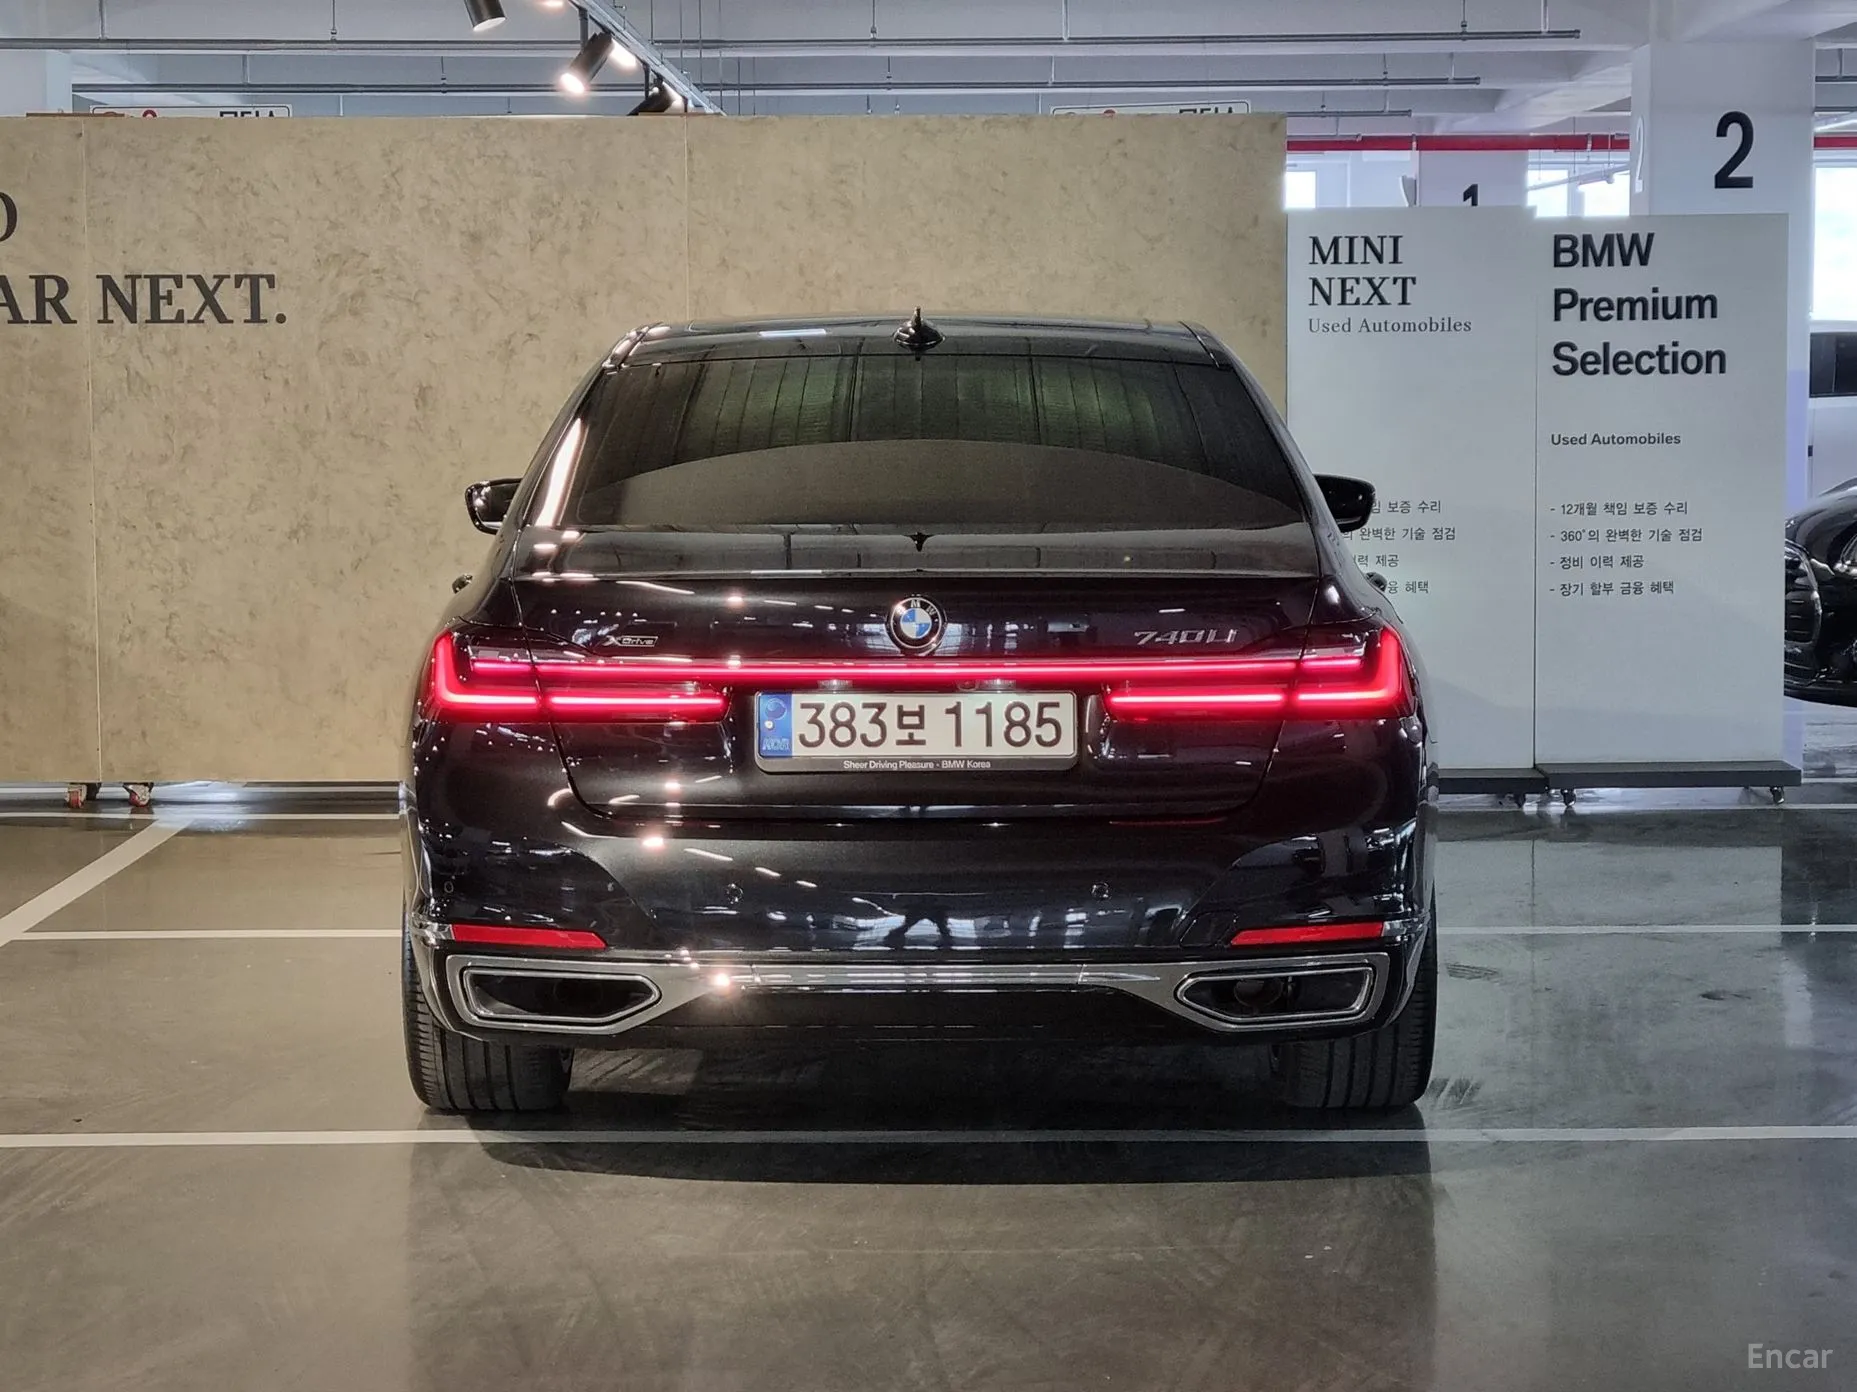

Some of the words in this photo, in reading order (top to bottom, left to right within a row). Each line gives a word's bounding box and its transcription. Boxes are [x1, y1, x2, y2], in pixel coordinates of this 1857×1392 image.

[1714, 111, 1754, 189] 2
[1308, 235, 1403, 264] MINI
[1553, 232, 1655, 267] BMW
[1308, 276, 1417, 306] NEXT
[96, 274, 286, 324] NEXT.
[1553, 287, 1718, 322] Premium
[1308, 317, 1351, 333] Used
[1358, 316, 1472, 332] Automobiles
[1552, 341, 1726, 376] Selection
[1551, 433, 1587, 445] Used
[1591, 432, 1681, 445] Automobiles
[1387, 500, 1411, 513] 보증
[1418, 500, 1441, 513] 수리
[1560, 502, 1597, 516] 12개월
[1603, 501, 1627, 515] 책임
[1633, 501, 1658, 515] 보증
[1664, 501, 1688, 515] 수리
[1360, 527, 1396, 540] 완벽한
[1402, 527, 1425, 540] 기술
[1432, 527, 1456, 540] 점검
[1605, 528, 1642, 542] 완벽한
[1649, 528, 1672, 542] 기술
[1678, 528, 1703, 541] 점검
[1354, 554, 1368, 567] 력
[1375, 554, 1399, 567] 제공
[1560, 556, 1583, 569] 정비
[1590, 555, 1613, 568] 이력
[1620, 555, 1644, 568] 제공
[1388, 580, 1399, 594] 융
[1405, 580, 1429, 594] 혜택
[1560, 583, 1584, 596] 장기
[1590, 582, 1614, 596] 할부
[1620, 581, 1644, 595] 금융
[1650, 581, 1674, 595] 혜택
[798, 701, 927, 748] 383보
[945, 701, 1062, 748] 1185
[843, 760, 867, 769] Sheer
[869, 760, 897, 770] Driving
[899, 760, 934, 769] Pleasure
[942, 760, 965, 769] BMW
[967, 760, 990, 769] Korea
